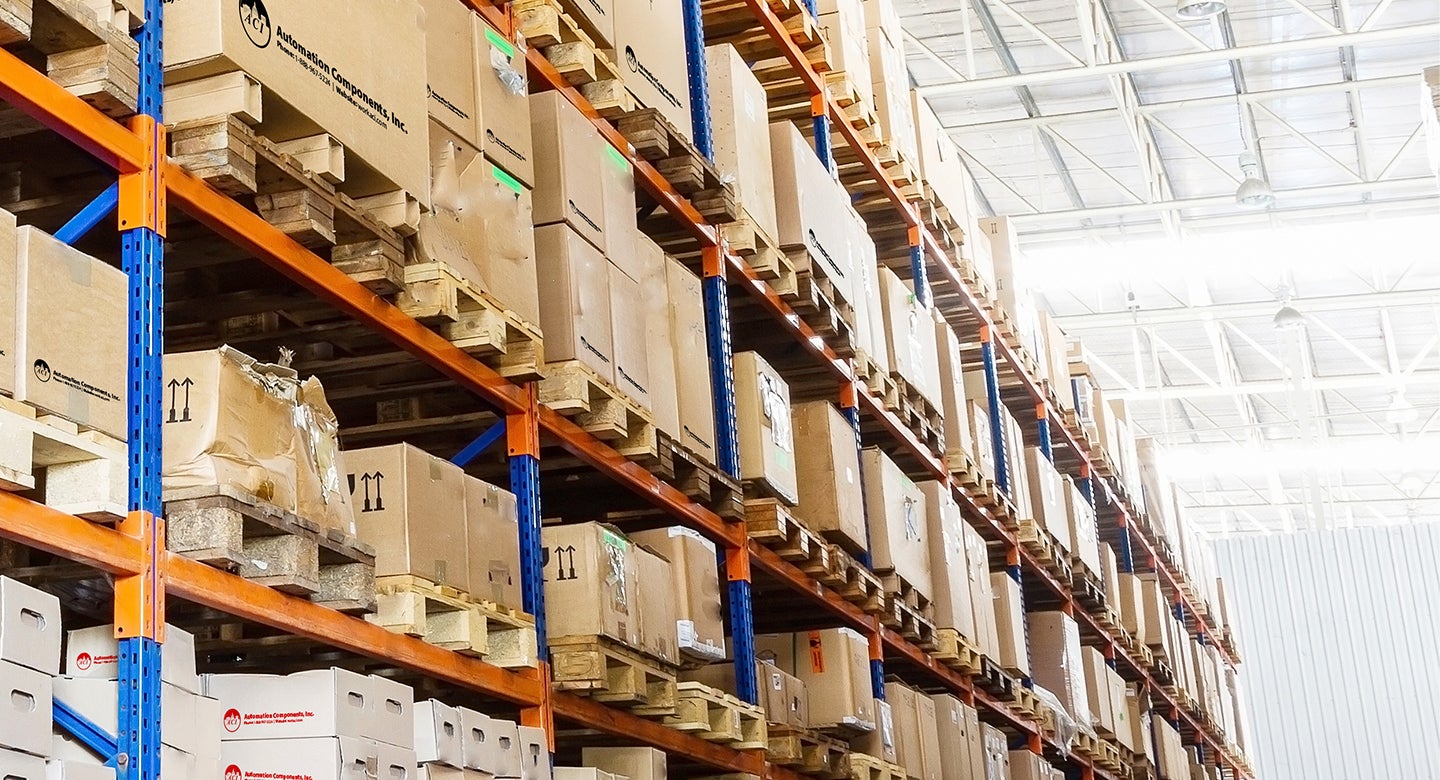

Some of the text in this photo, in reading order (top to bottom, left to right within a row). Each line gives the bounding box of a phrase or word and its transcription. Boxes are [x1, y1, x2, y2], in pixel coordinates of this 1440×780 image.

[244, 13, 264, 34] ACI
[276, 25, 330, 74] Automation
[331, 67, 390, 121] Components,
[391, 112, 408, 134] Inc.
[276, 40, 295, 60] Phone:
[335, 85, 357, 107] Website:
[357, 103, 387, 130] workaci.com
[53, 370, 80, 386] Automation
[111, 393, 121, 402] Inc.
[272, 711, 305, 719] Components,
